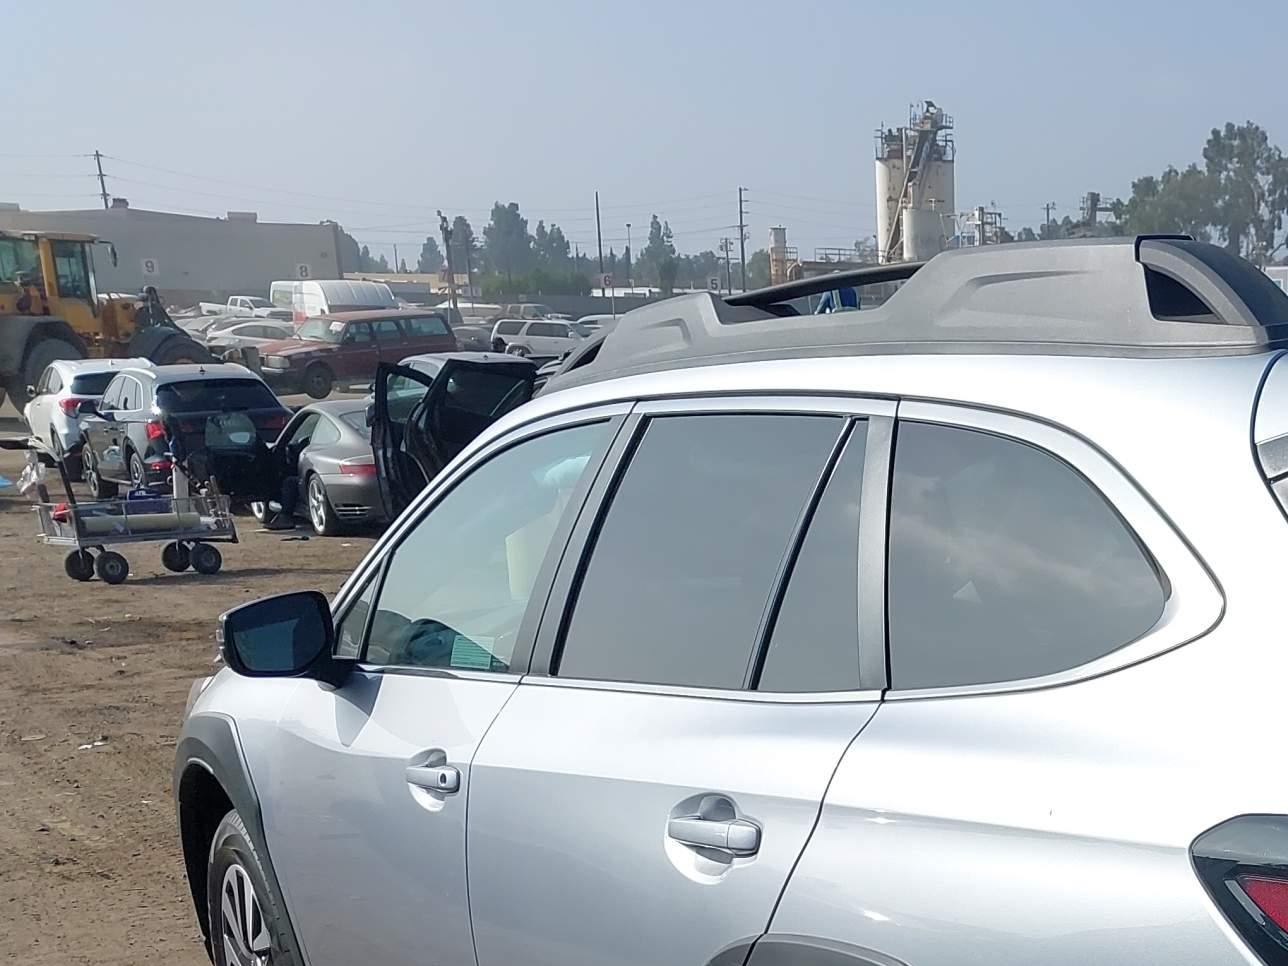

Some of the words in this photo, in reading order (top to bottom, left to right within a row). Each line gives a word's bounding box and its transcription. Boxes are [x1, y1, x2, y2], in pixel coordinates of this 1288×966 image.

[144, 260, 155, 273] 9
[604, 275, 611, 286] 6
[710, 278, 718, 290] 5
